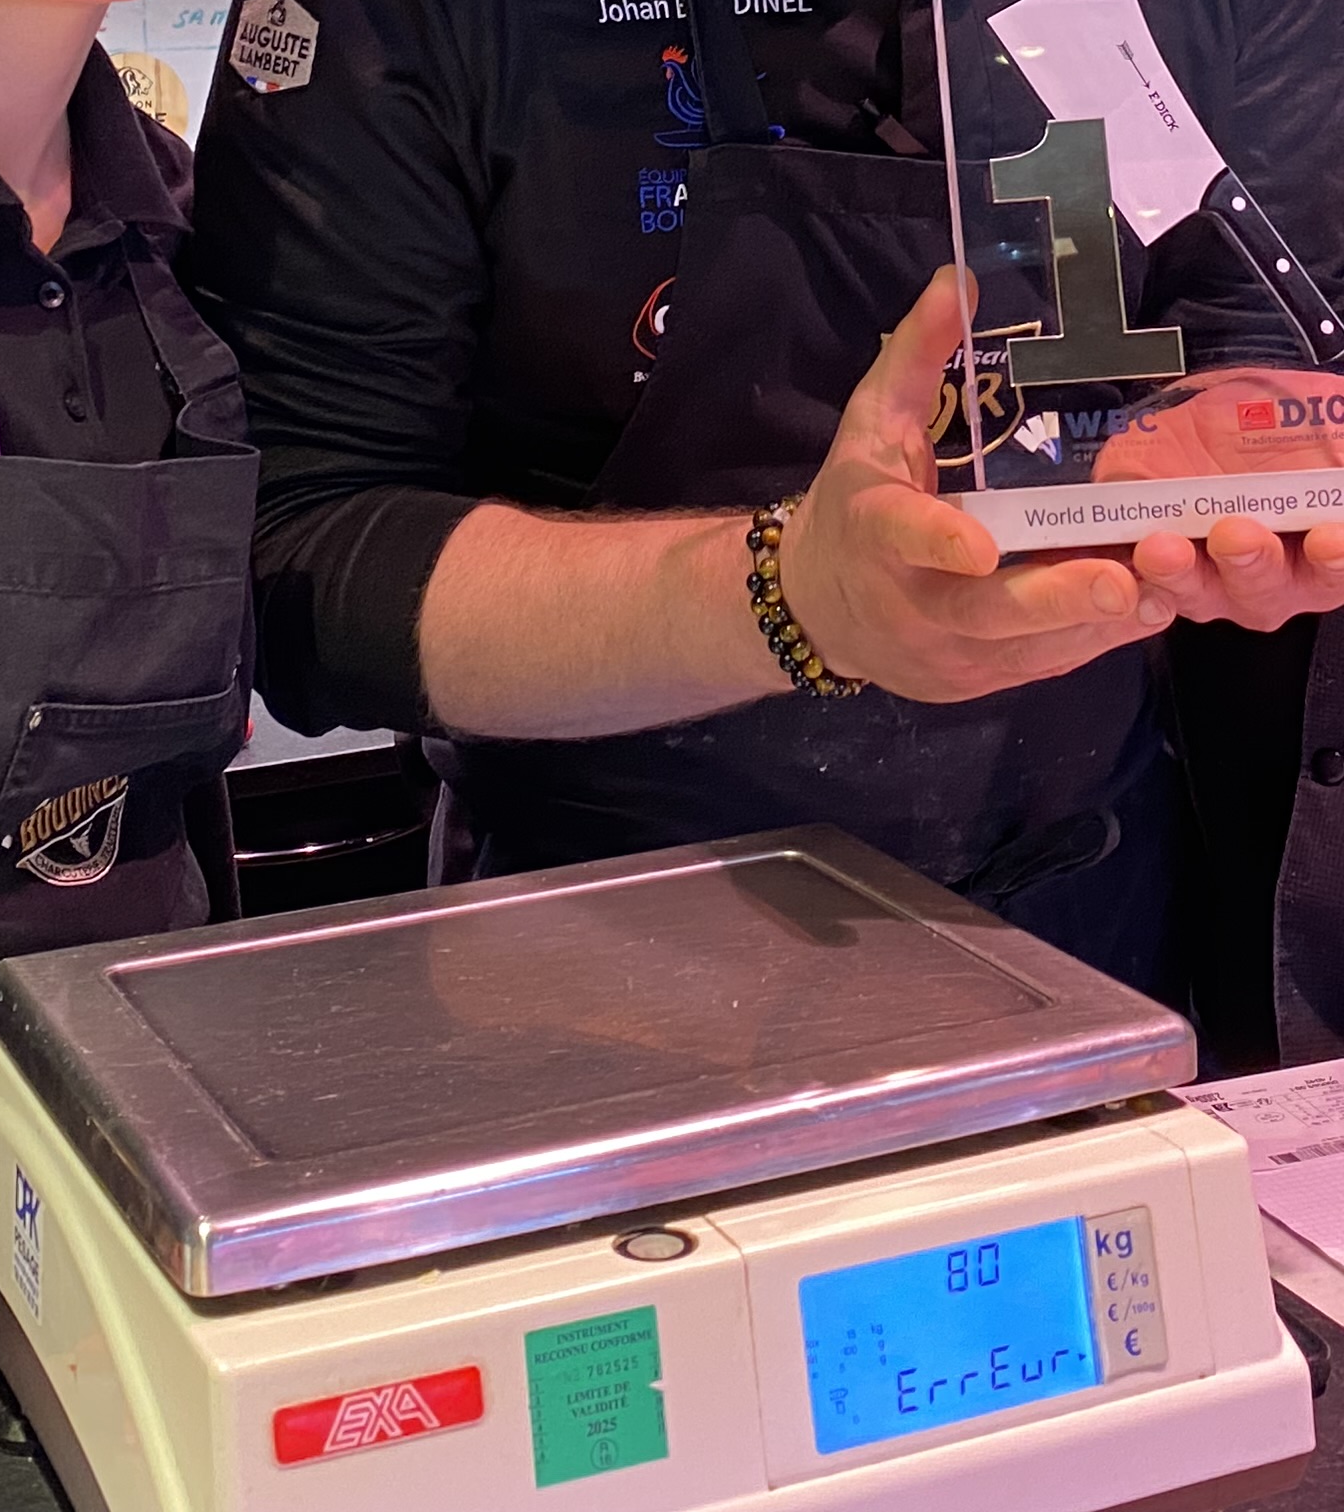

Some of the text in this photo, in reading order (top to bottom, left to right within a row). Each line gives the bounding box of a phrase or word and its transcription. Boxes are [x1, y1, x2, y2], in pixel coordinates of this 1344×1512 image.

[239, 21, 311, 59] AUGUSTE
[239, 45, 300, 77] LAMBERT
[1154, 100, 1179, 133] DICK
[990, 118, 1185, 388] 1
[1064, 407, 1158, 438] WBC
[1241, 432, 1328, 446] Traditionsmarke
[1024, 506, 1085, 528] World
[1092, 499, 1187, 523] Butchers'
[1195, 491, 1299, 516] Challenge
[1095, 1229, 1133, 1258] kg
[947, 1243, 1000, 1292] 80
[534, 1329, 653, 1365] RECONNU CONFORME
[556, 1319, 630, 1345] INSTRUMENT
[1124, 1328, 1142, 1357] €
[567, 1381, 630, 1405] LIMITE DE
[897, 1345, 1069, 1414] ErrEur
[323, 1383, 441, 1453] EXA
[571, 1394, 629, 1419] VALIDITÉ
[586, 1417, 618, 1437] 2025
